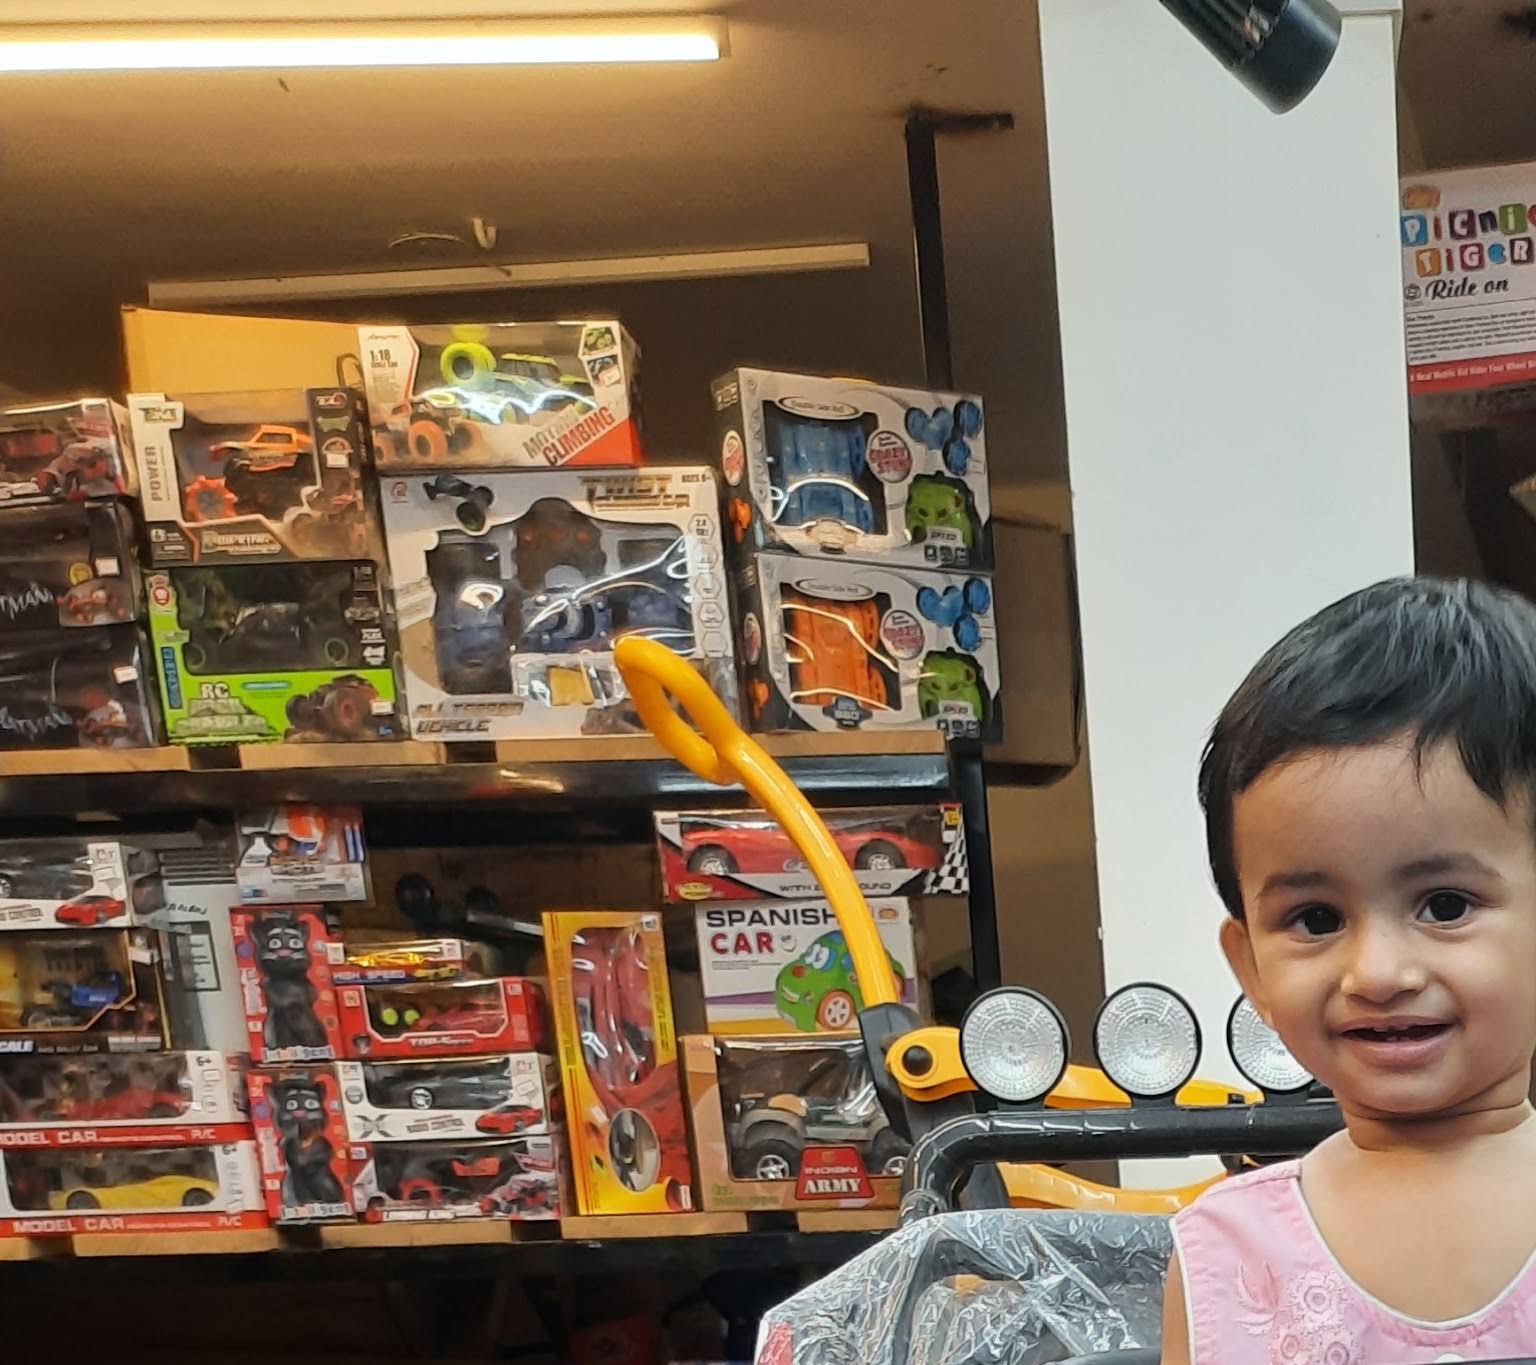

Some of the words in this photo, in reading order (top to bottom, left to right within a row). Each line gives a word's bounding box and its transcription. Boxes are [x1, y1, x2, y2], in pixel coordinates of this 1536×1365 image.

[1425, 276, 1478, 301] Ride
[1484, 277, 1510, 294] on
[542, 405, 616, 466] CLIMBING
[144, 446, 162, 501] POWER
[201, 682, 230, 699] RC
[706, 907, 836, 929] SPANISH
[710, 931, 776, 956] CAR
[57, 1130, 98, 1144] CAR
[803, 1177, 862, 1195] ARMY
[13, 1218, 77, 1234] MODEL
[84, 1217, 126, 1231] CAR
